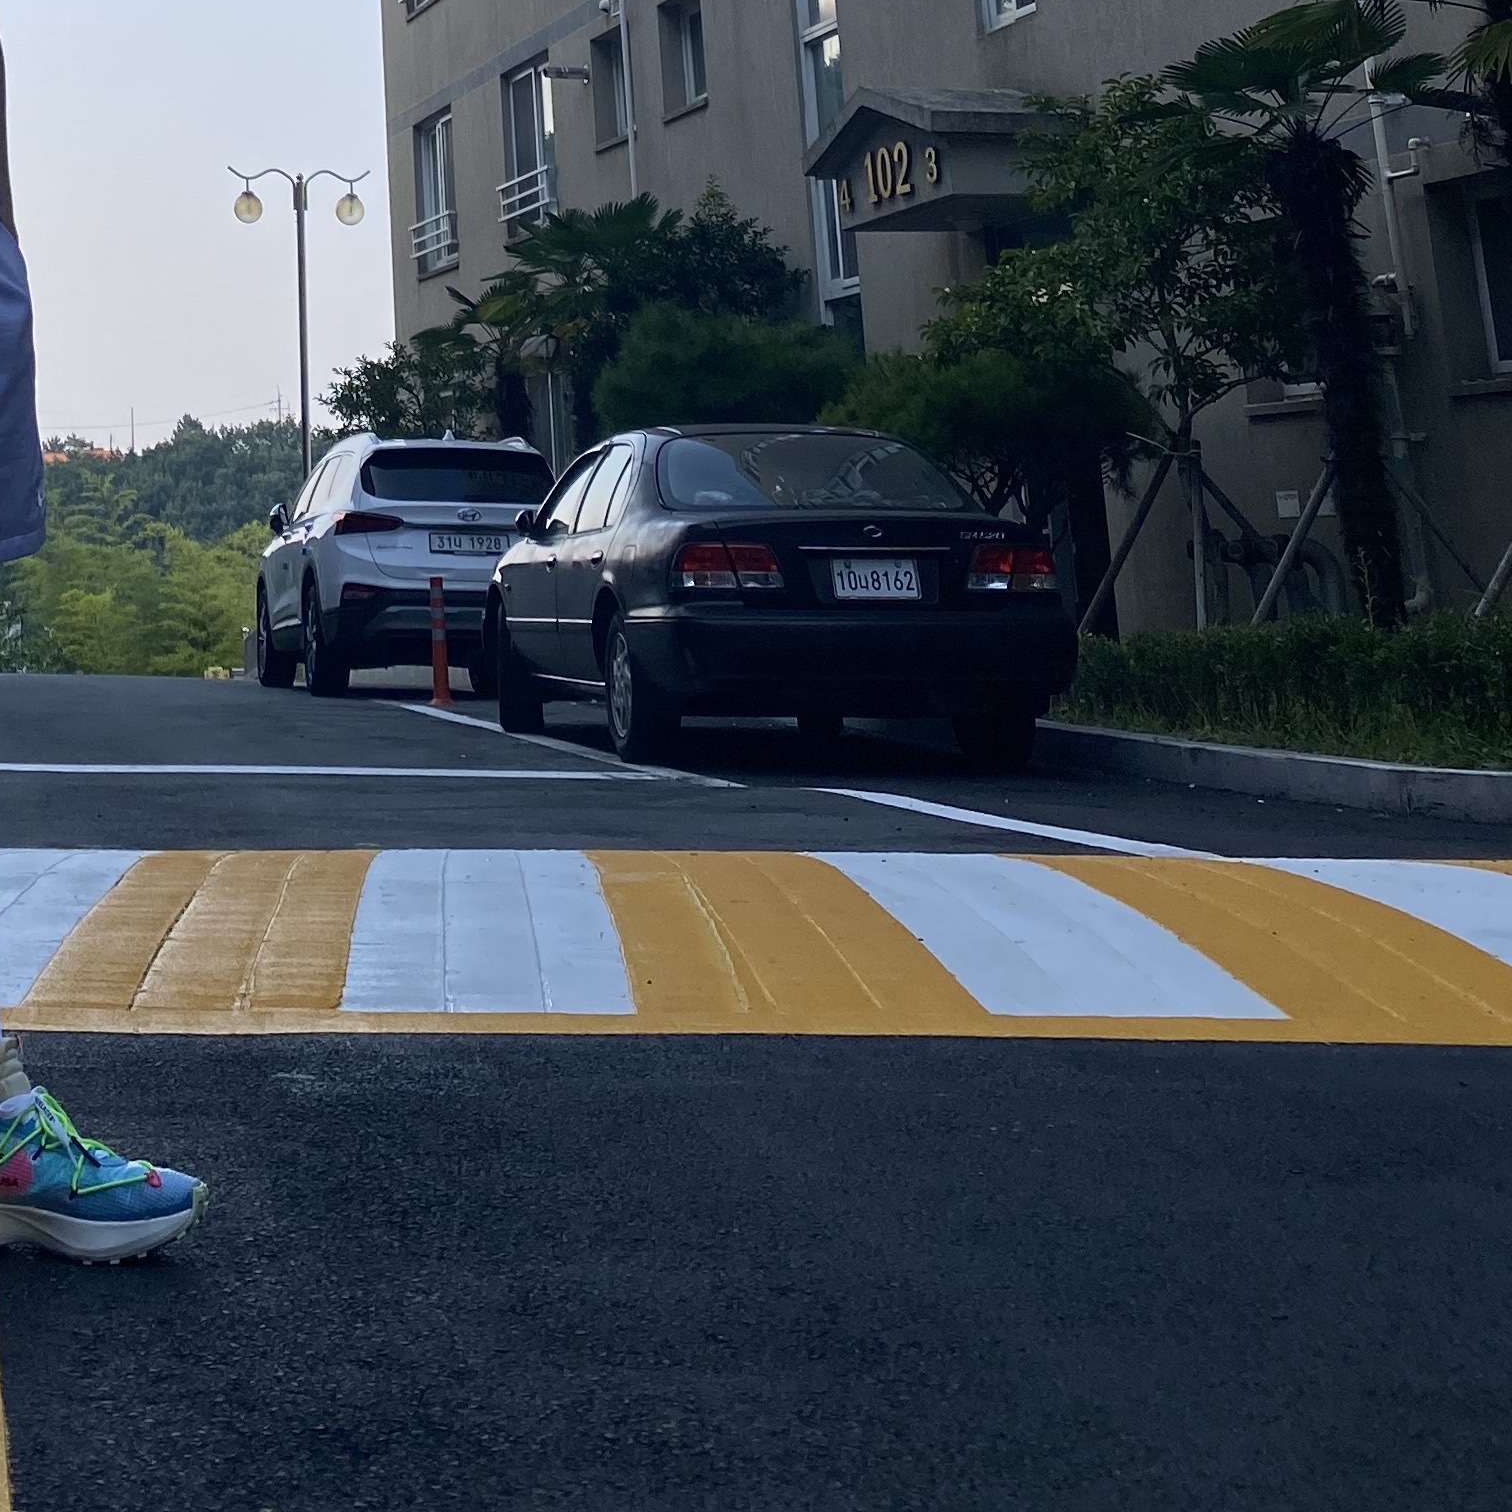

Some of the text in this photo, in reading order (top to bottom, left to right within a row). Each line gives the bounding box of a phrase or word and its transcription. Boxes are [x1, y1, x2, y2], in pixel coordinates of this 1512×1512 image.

[840, 141, 937, 213] 4 102 3
[470, 537, 502, 551] 1928
